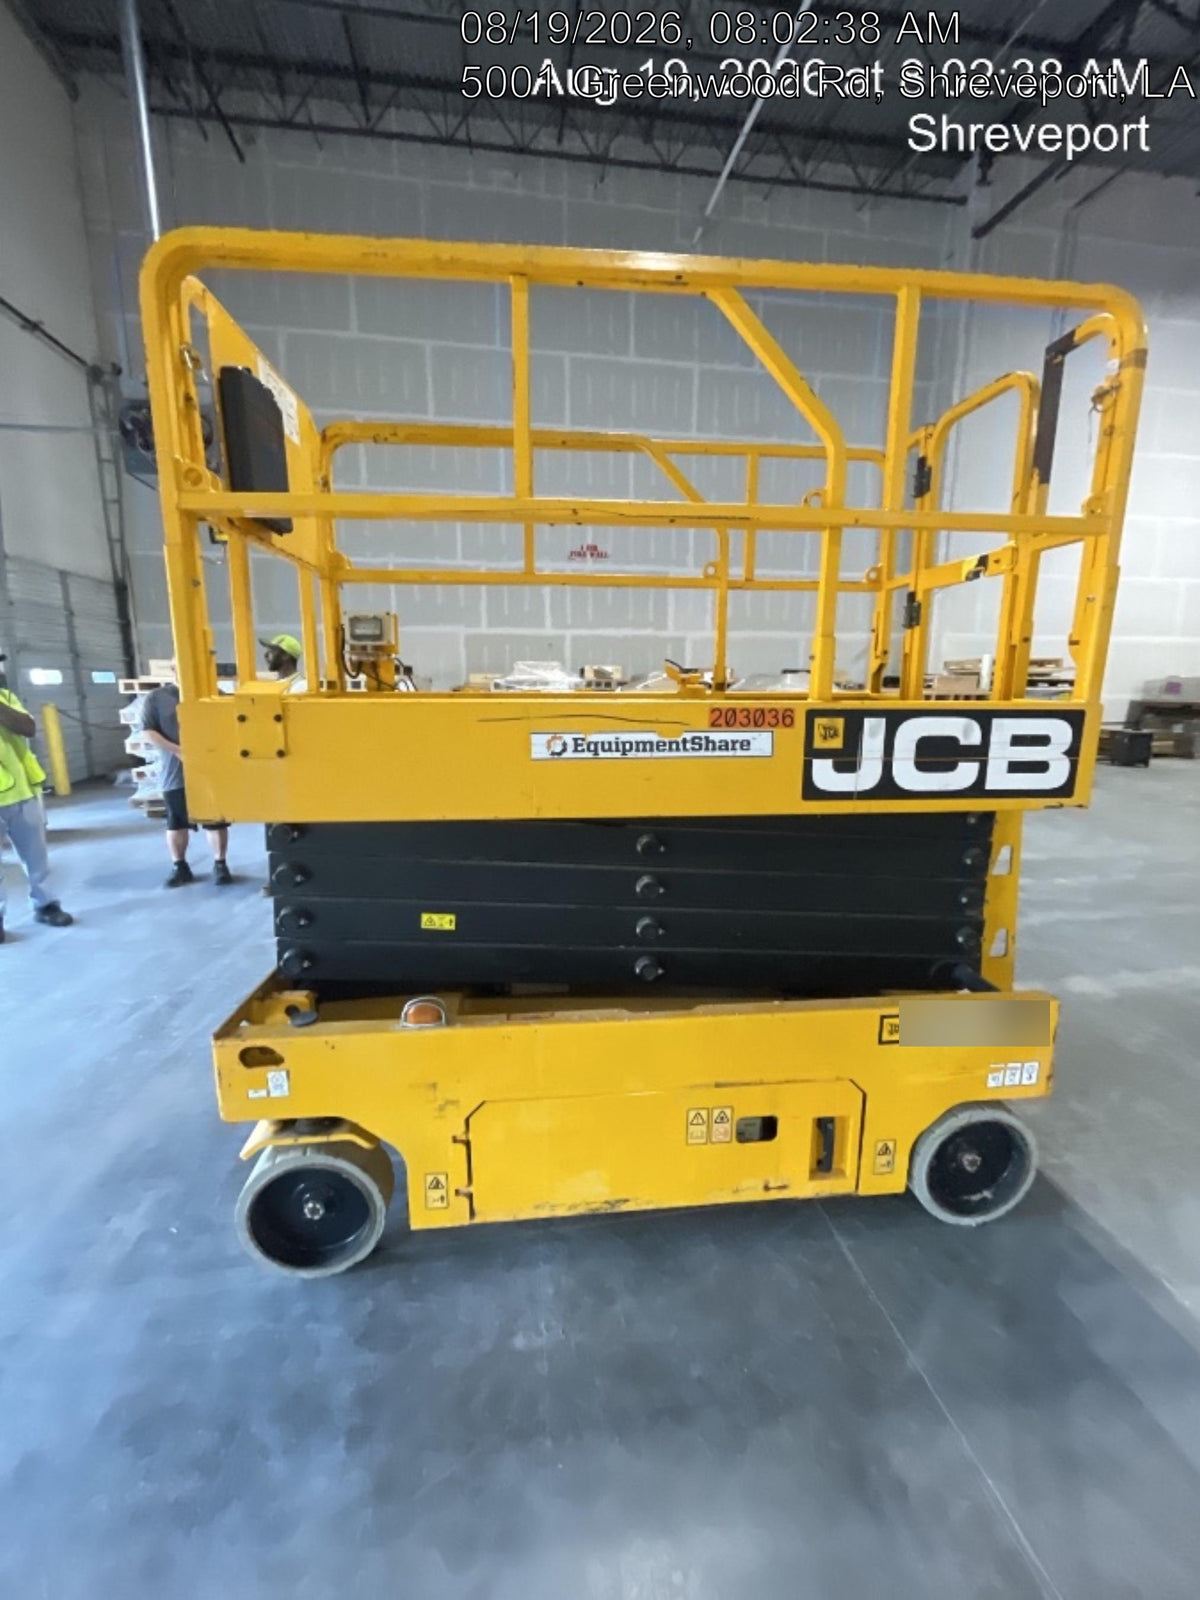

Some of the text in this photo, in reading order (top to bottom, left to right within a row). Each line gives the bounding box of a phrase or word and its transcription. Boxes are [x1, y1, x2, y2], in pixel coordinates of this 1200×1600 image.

[709, 707, 795, 729] 203036
[572, 736, 751, 756] EquipmentShare
[811, 716, 1072, 793] JCB
